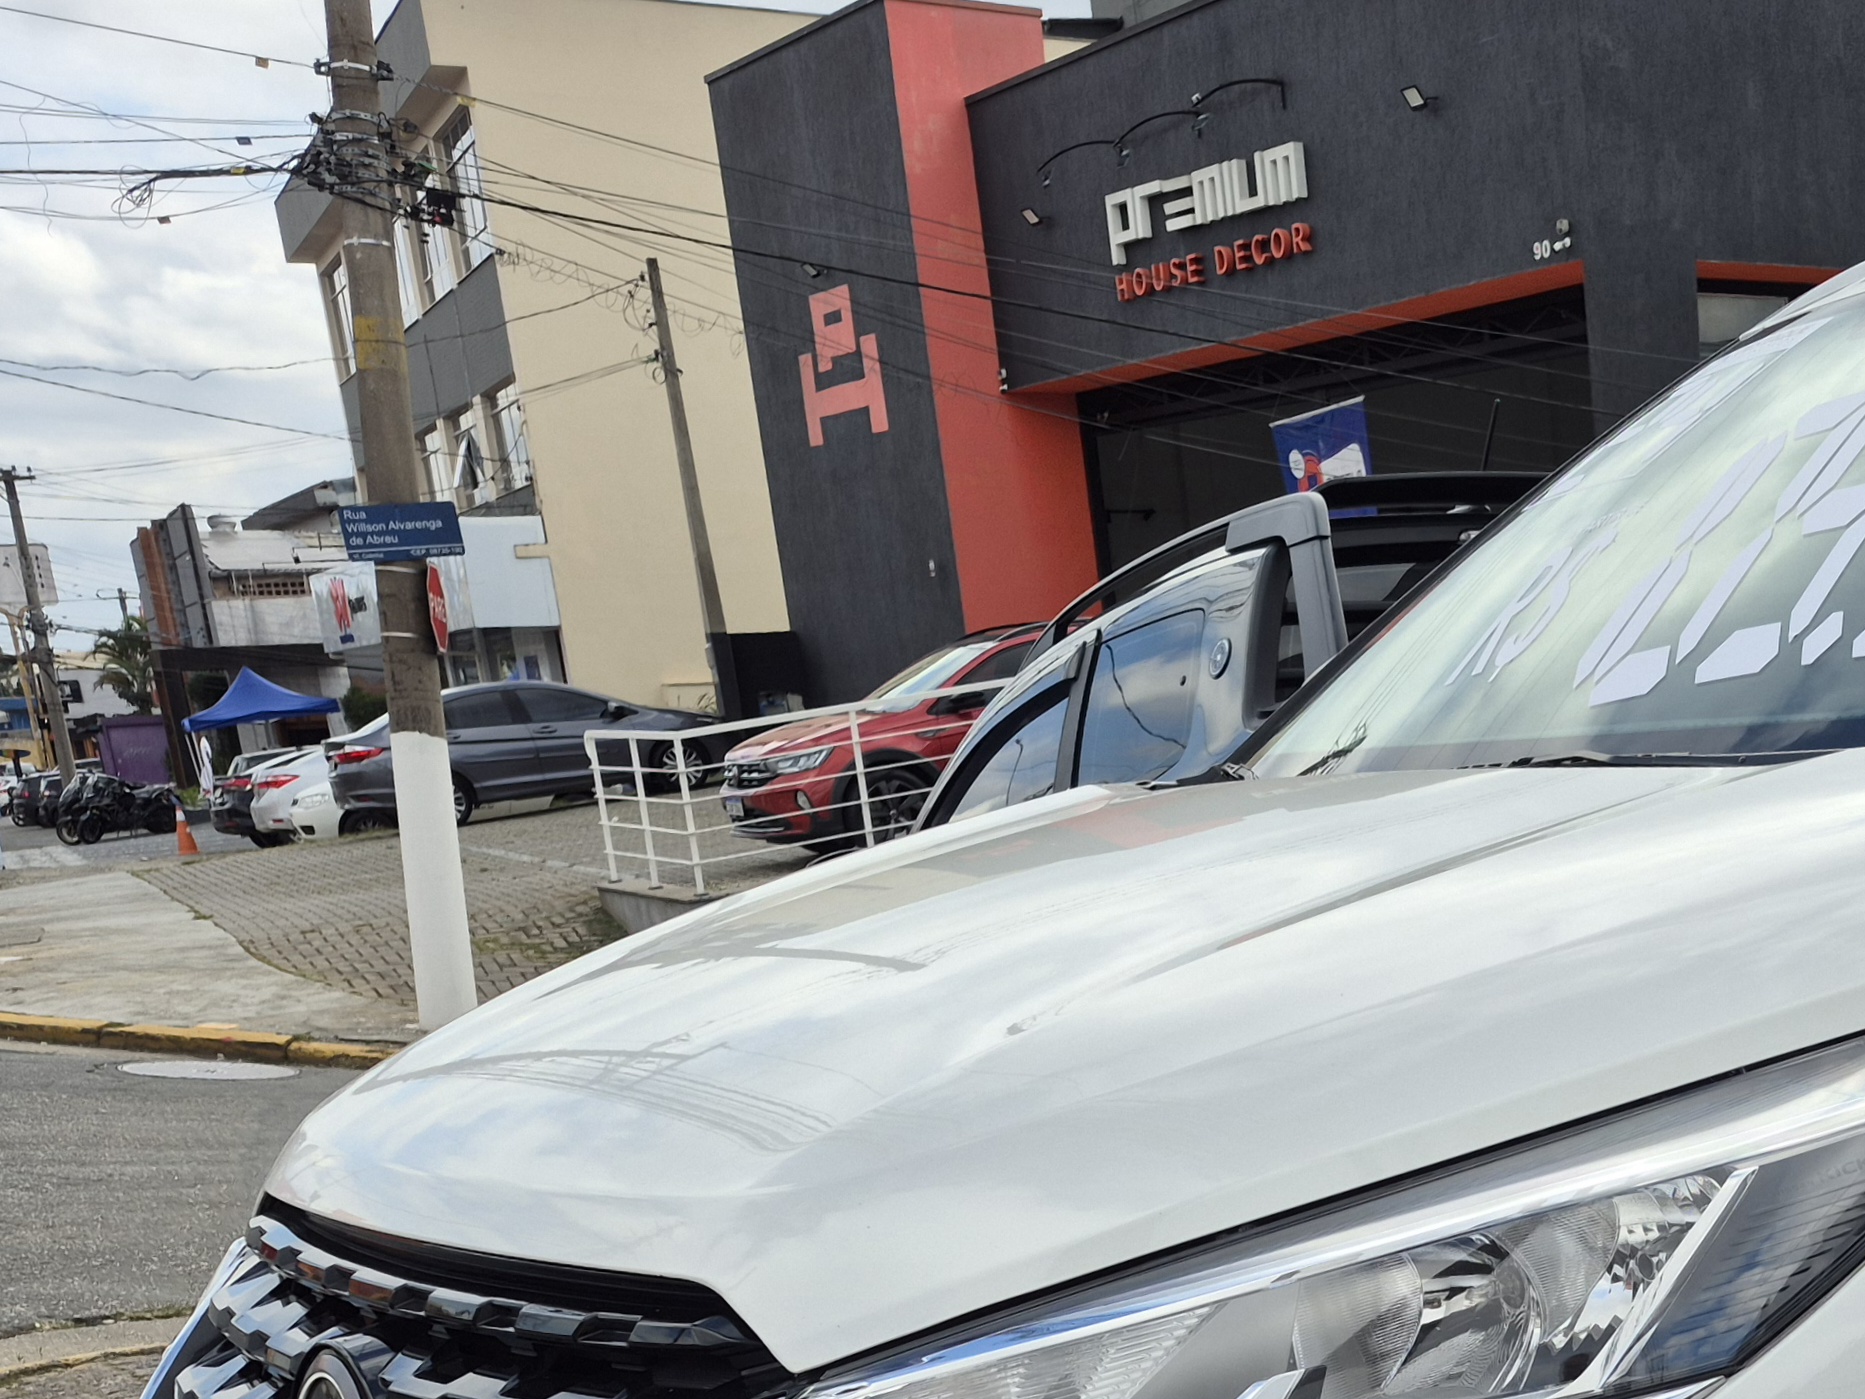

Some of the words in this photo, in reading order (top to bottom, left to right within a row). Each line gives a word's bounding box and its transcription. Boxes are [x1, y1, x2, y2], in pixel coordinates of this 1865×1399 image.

[1533, 239, 1551, 260] 90
[1115, 252, 1206, 302] HOUSE
[1214, 222, 1313, 275] DECOR
[343, 509, 367, 520] Rua
[345, 522, 386, 533] Willson
[388, 520, 443, 531] Alvarenga
[349, 536, 364, 546] de
[366, 534, 399, 545] Abreu
